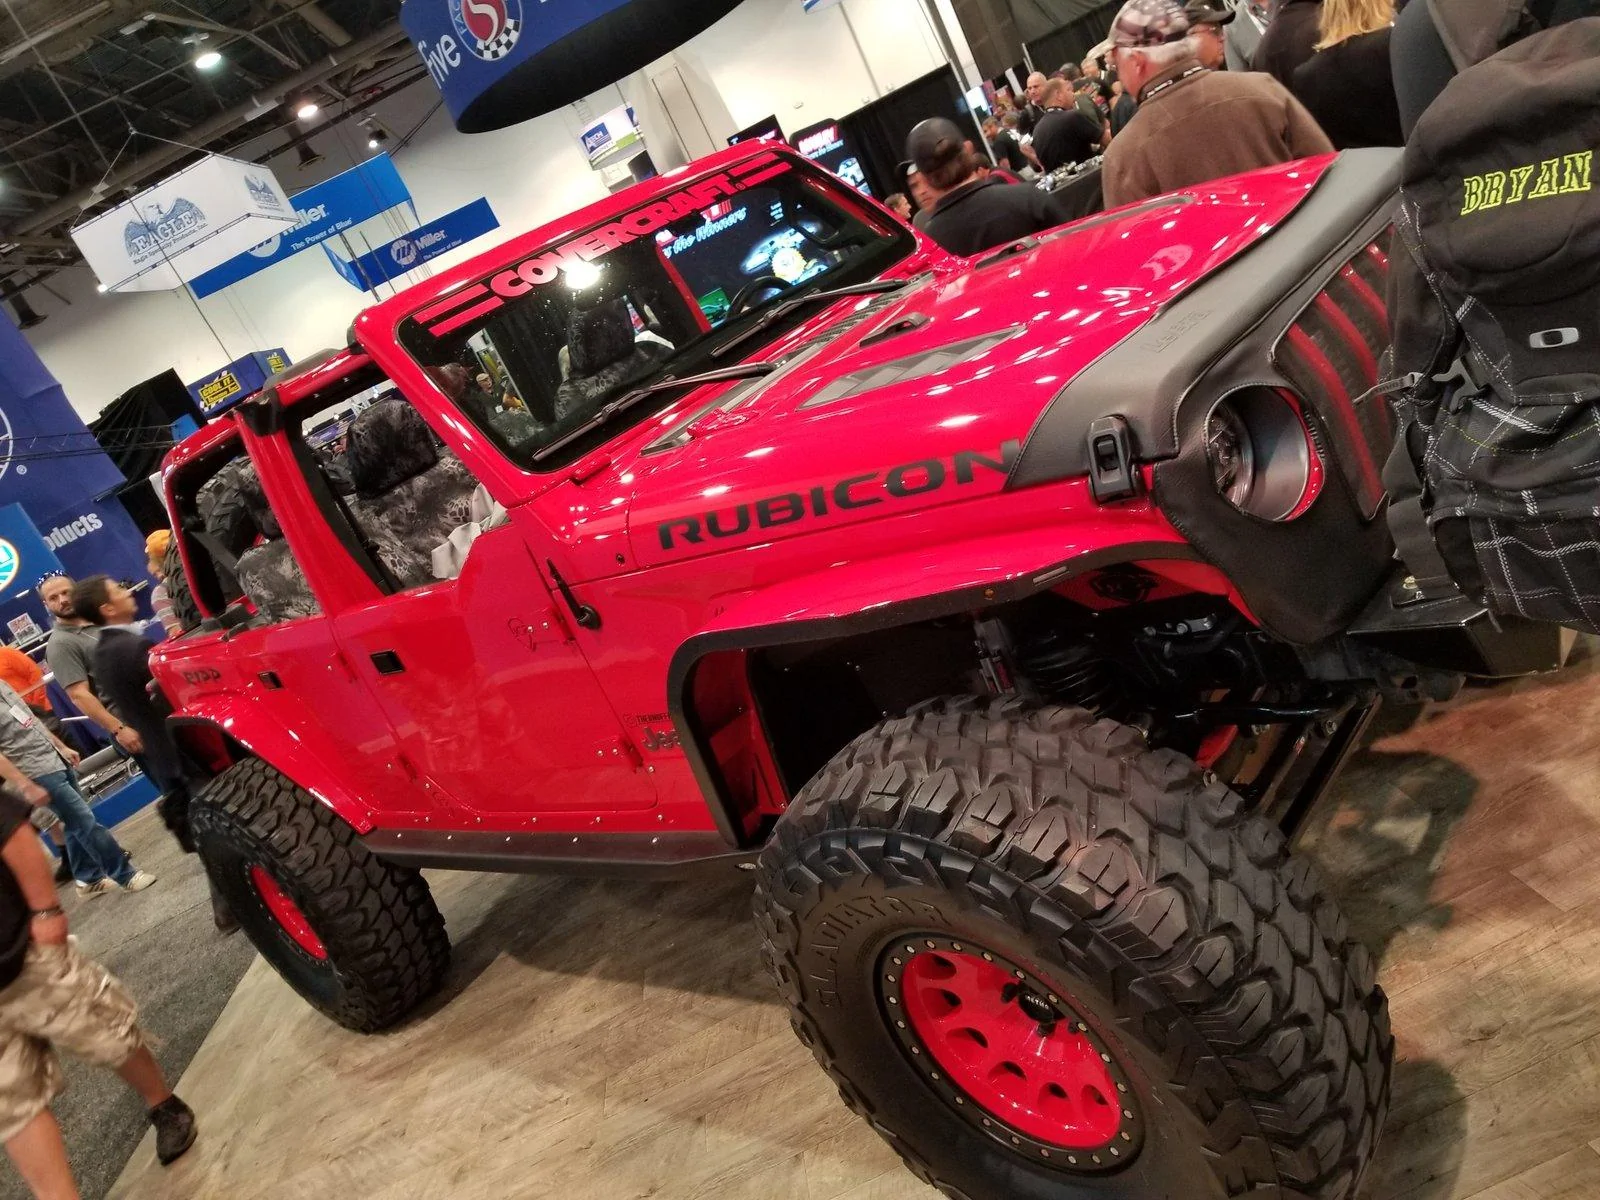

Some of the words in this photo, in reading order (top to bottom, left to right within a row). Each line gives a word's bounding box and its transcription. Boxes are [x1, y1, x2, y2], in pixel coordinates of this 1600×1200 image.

[1461, 150, 1593, 216] BRYAN
[131, 211, 198, 254] EAGLE
[290, 242, 307, 252] The
[305, 230, 328, 244] Power
[327, 225, 336, 234] of
[415, 229, 446, 251] Miller
[490, 170, 739, 298] COVERCRAFT
[657, 437, 1020, 550] RUBICON
